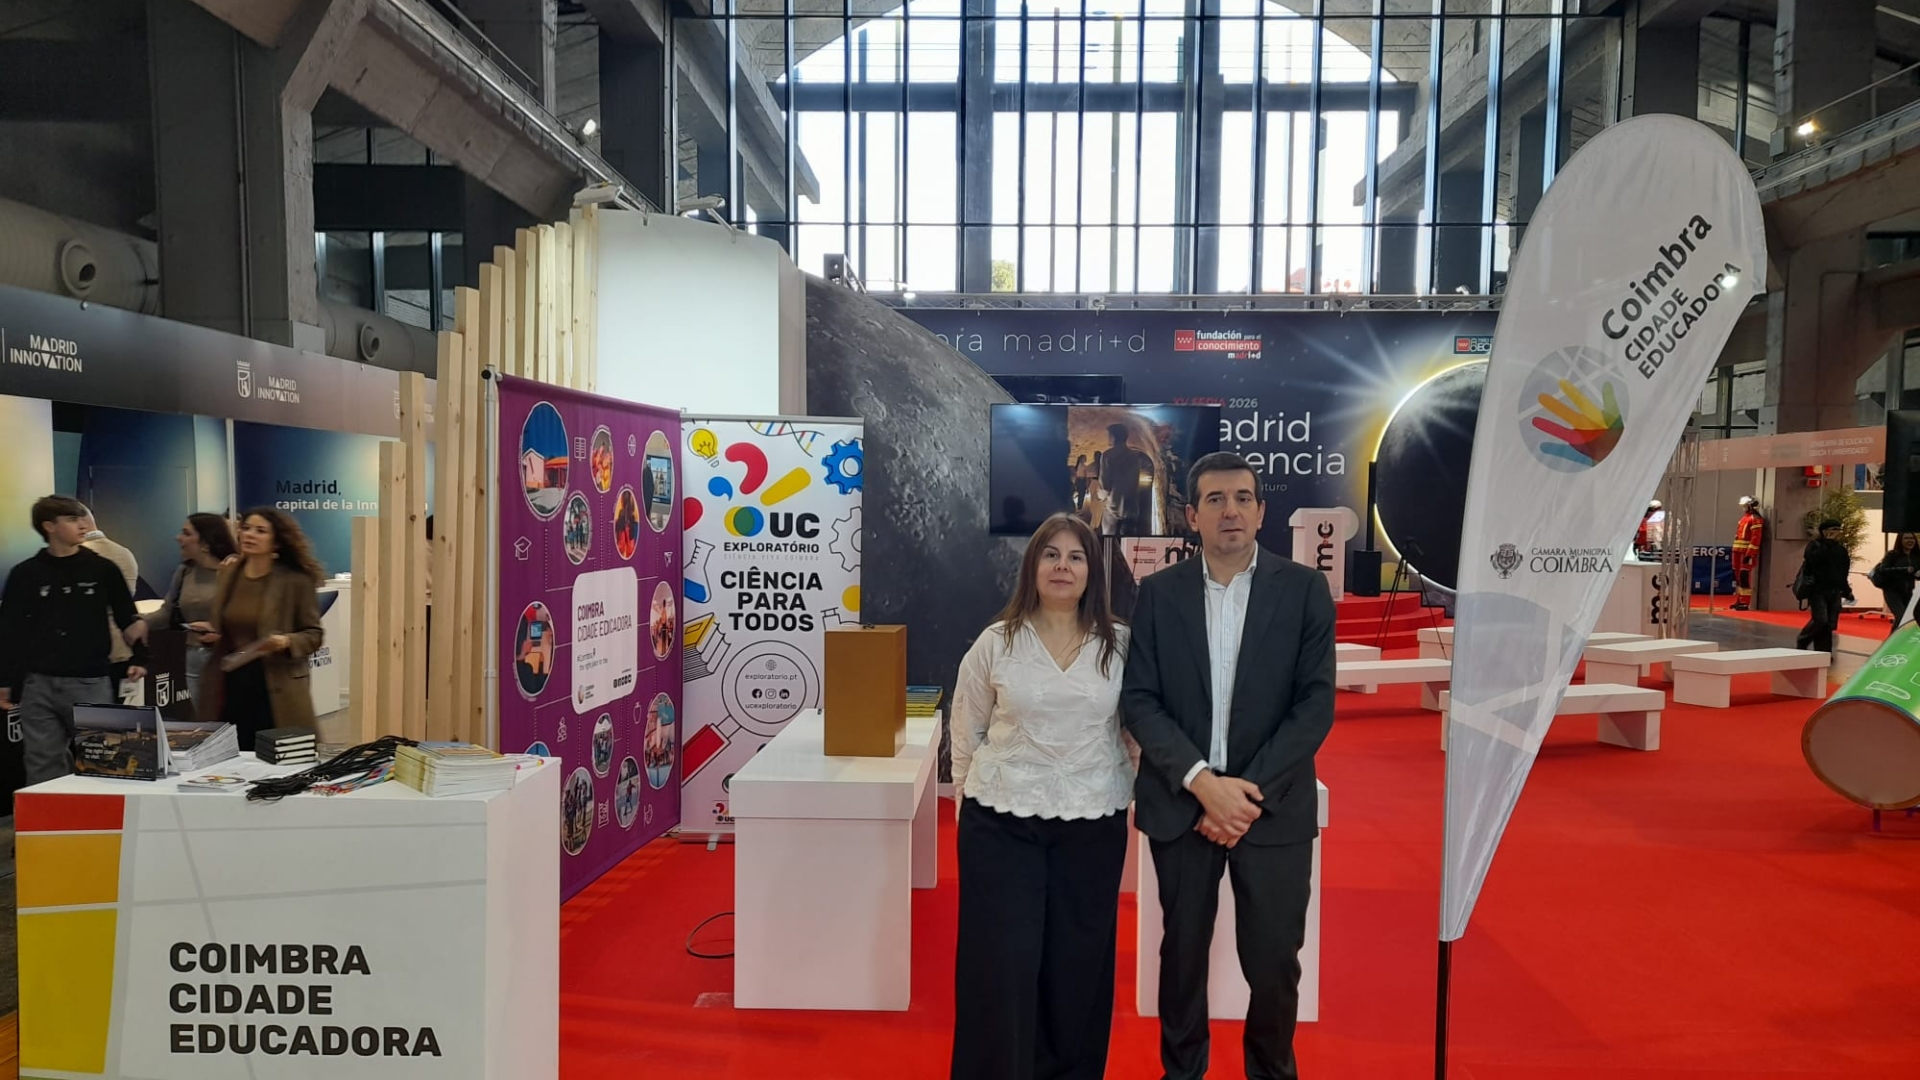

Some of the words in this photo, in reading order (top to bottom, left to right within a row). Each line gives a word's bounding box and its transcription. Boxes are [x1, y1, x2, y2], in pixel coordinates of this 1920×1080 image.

[1602, 215, 1712, 339] Coimbra
[1625, 288, 1689, 361] CIDADE
[1003, 328, 1145, 352] madri+d
[1196, 330, 1241, 339] fundación
[30, 334, 78, 355] MADRID
[1198, 342, 1259, 350] conocimiento
[10, 347, 82, 373] INNOVATION
[268, 376, 297, 391] MADRID
[257, 387, 300, 403] INNOVATION
[1228, 398, 1258, 408] 2026
[1219, 411, 1311, 442] adrid
[276, 480, 342, 496] Madrid,
[275, 499, 319, 512] capital
[323, 499, 338, 510] de
[342, 499, 353, 510] la
[357, 500, 377, 510] Inn
[770, 512, 820, 538] UC
[724, 541, 819, 553] EXPLORATÓRIO
[1569, 547, 1613, 557] MUNICIPAL
[1692, 547, 1725, 557] EROS
[1530, 556, 1613, 573] COIMBRA
[720, 566, 823, 590] CIÊNCIA
[578, 601, 604, 621] COIMBRA
[738, 592, 806, 611] PARA
[728, 613, 814, 632] TODOS
[169, 941, 371, 976] COIMBRA
[169, 982, 333, 1015] CIDADE
[169, 1023, 442, 1057] EDUCADORA
